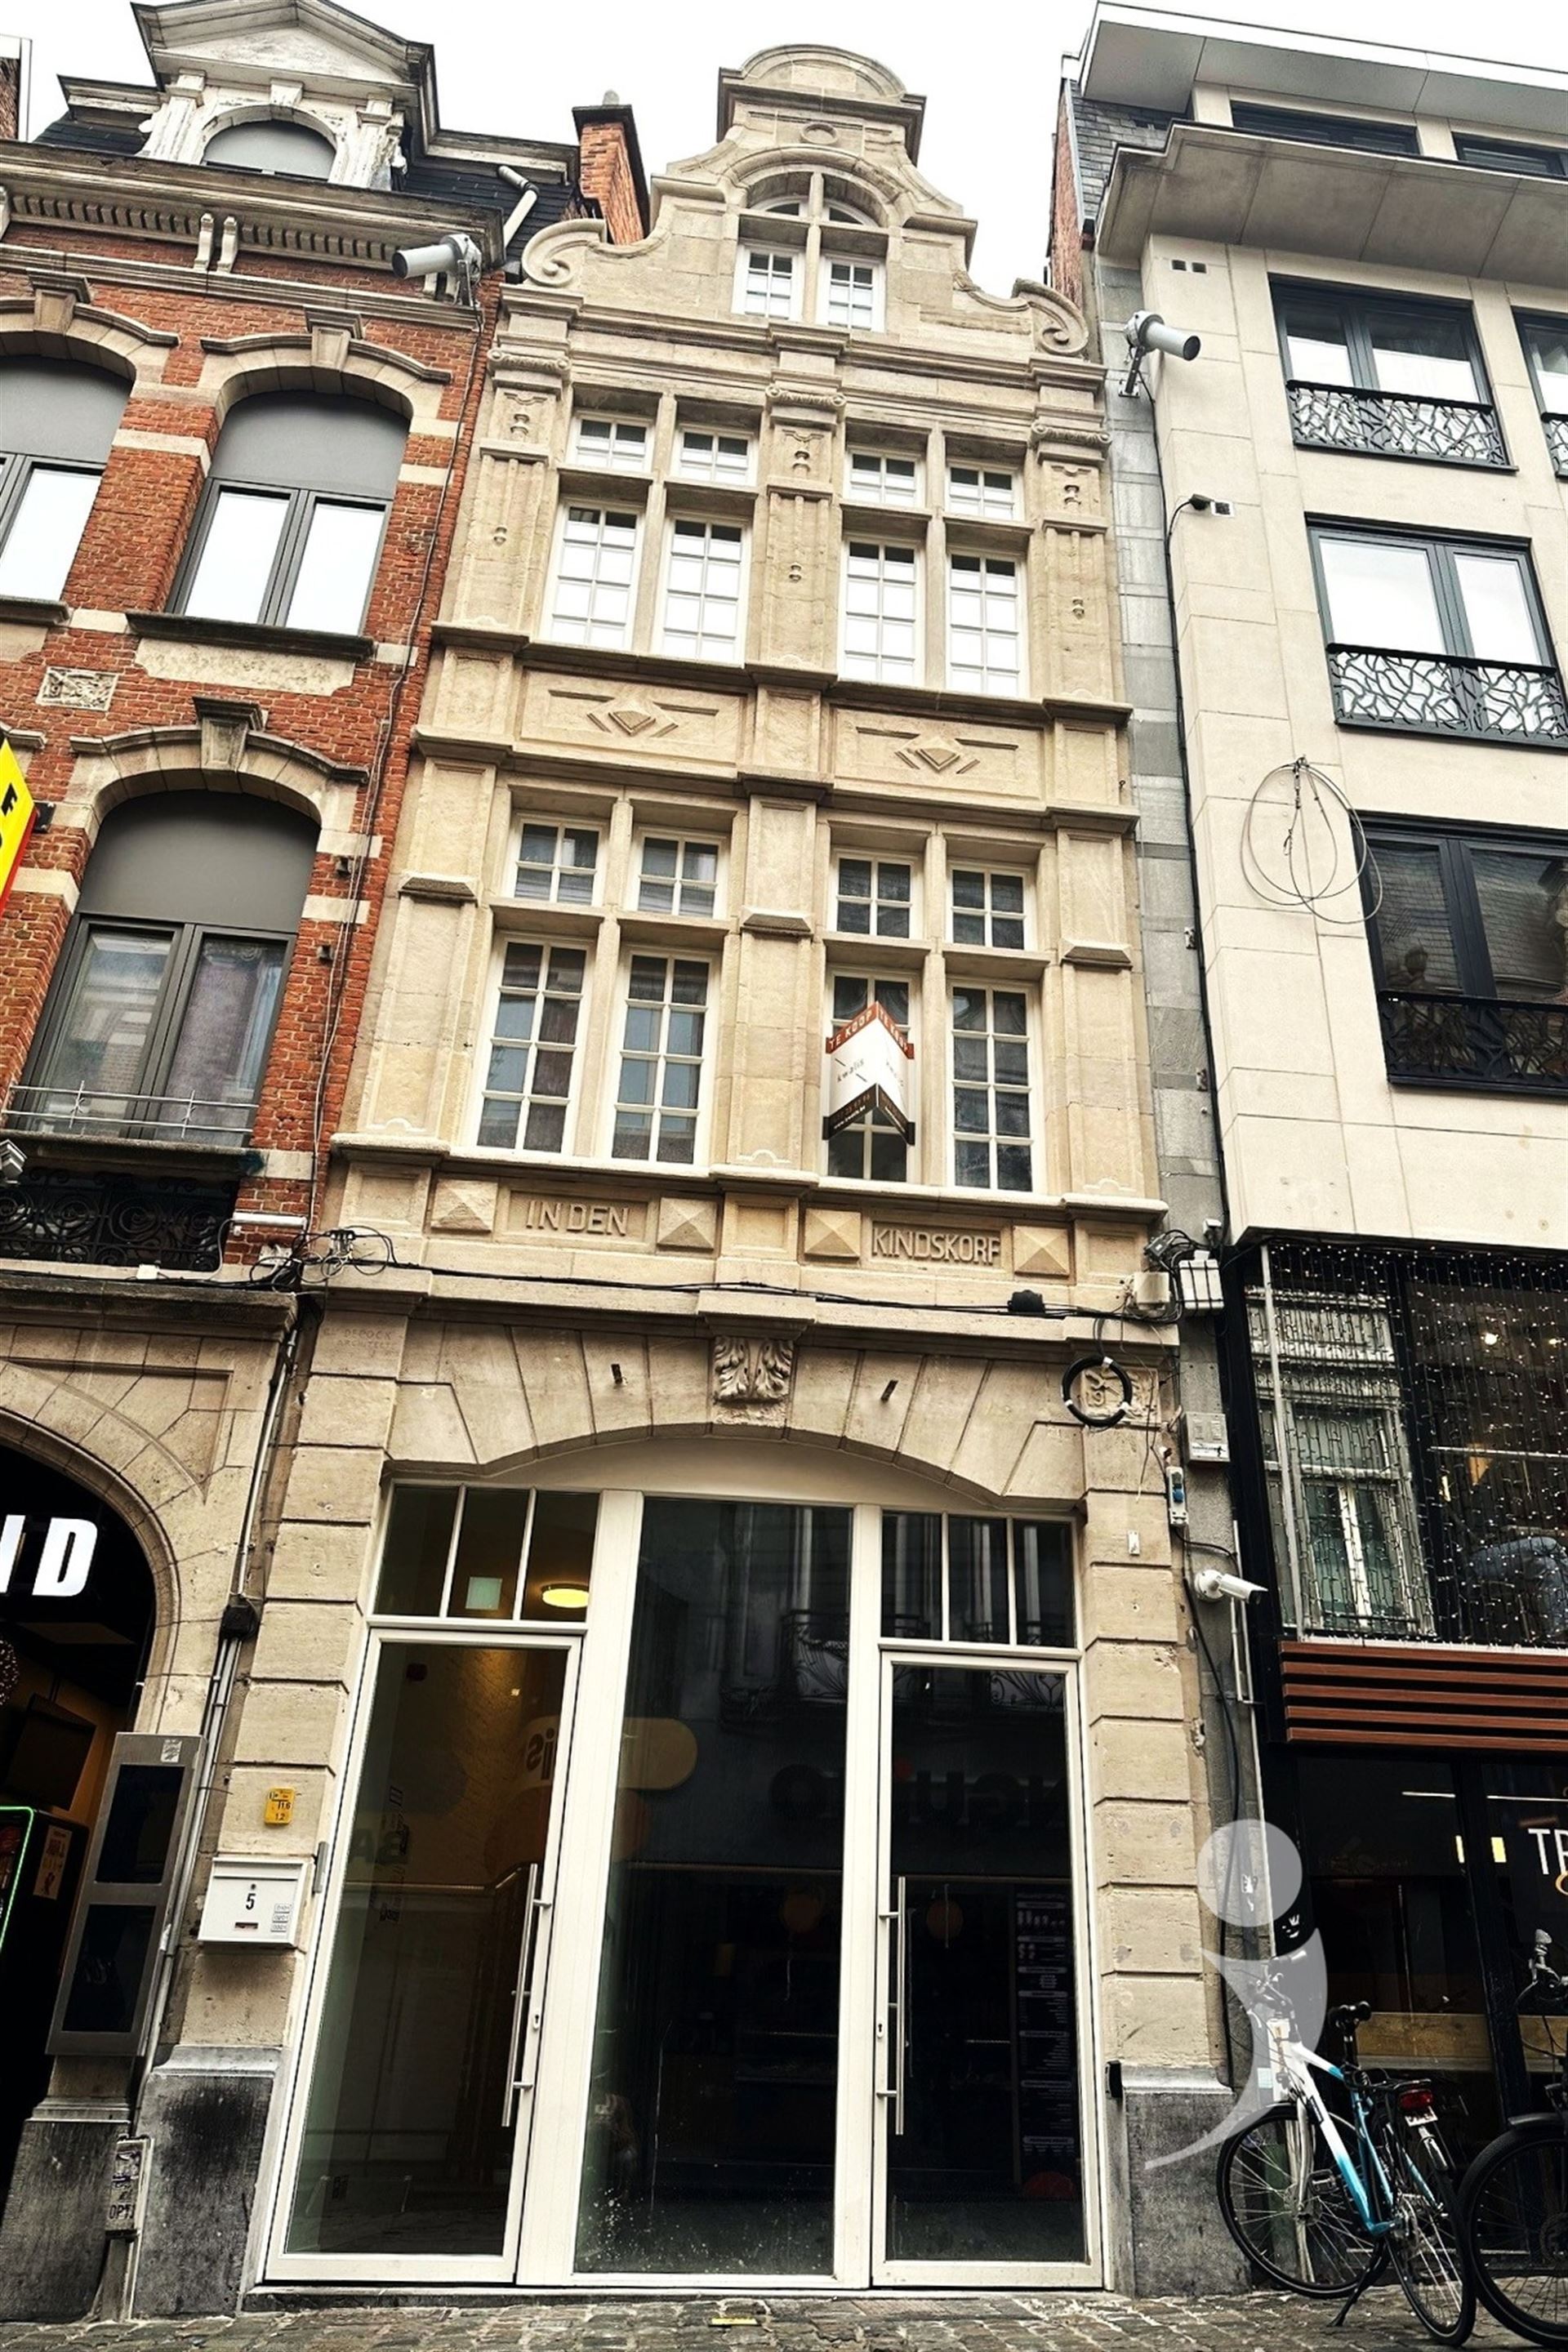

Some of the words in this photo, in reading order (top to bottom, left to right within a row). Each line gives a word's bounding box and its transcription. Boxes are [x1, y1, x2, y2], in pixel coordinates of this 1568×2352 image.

[828, 1034, 842, 1050] TE
[844, 1009, 872, 1039] KOOP
[526, 1200, 563, 1231] IN
[566, 1203, 629, 1236] DEN
[872, 1227, 1000, 1266] KINDSKORF
[245, 1892, 256, 1910] 5
